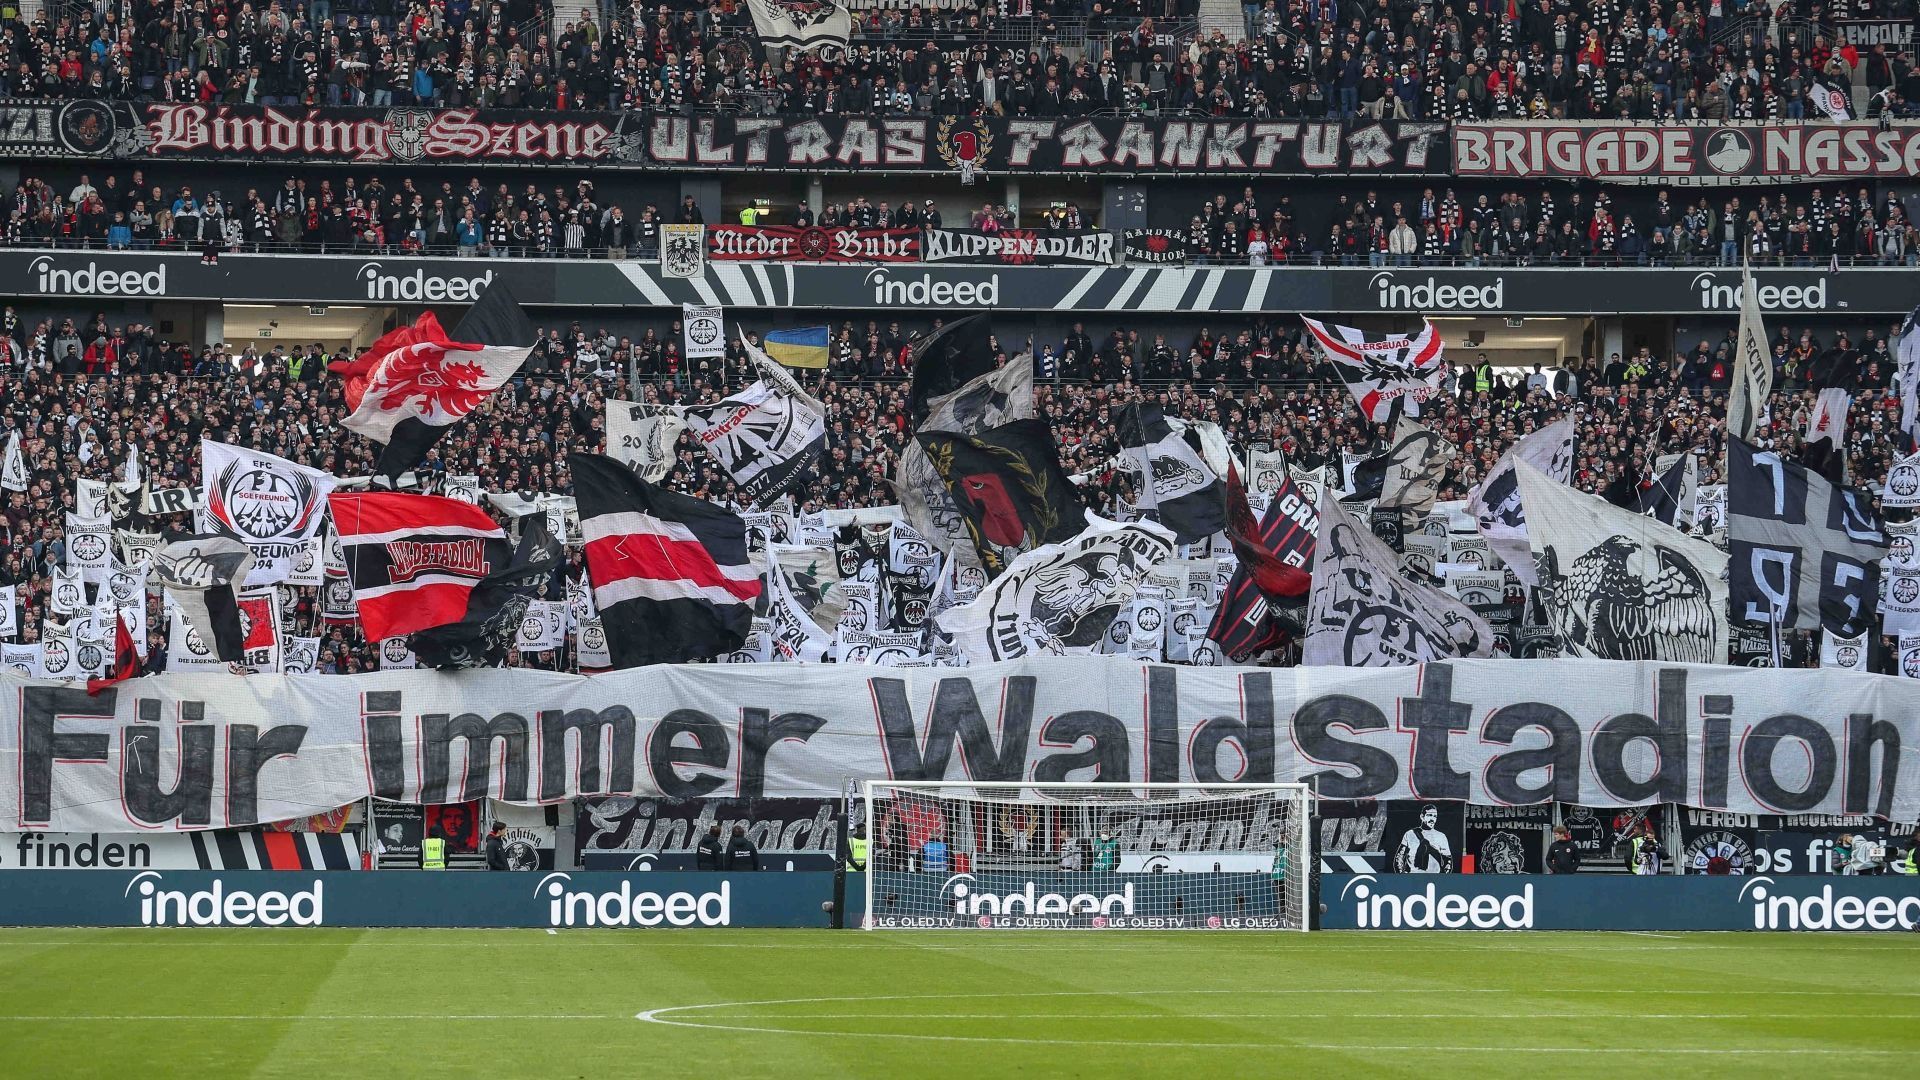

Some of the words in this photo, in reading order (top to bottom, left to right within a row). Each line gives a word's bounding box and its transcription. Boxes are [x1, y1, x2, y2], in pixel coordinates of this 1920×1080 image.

[147, 103, 392, 161] Binding
[426, 108, 613, 160] Szene
[650, 116, 926, 165] ULTRAS
[1008, 119, 1448, 170] FRANKFURT
[1454, 126, 1698, 178] BRIGADE
[1638, 175, 1803, 187] HOOLIGANS
[713, 229, 796, 257] Nieder
[834, 229, 913, 258] Bube
[925, 229, 1115, 264] KLIPPENADLER
[38, 262, 166, 297] indeed
[366, 267, 493, 301] indeed
[873, 273, 999, 306] indeed
[1378, 277, 1503, 310] indeed
[683, 309, 723, 320] WALDSTADION
[622, 434, 642, 450] 20
[252, 460, 273, 470] EFC
[1451, 540, 1489, 552] WALDSTADION
[333, 588, 350, 600] 25
[1451, 578, 1501, 592] WALDSTADION
[870, 635, 920, 651] WALDSTADION
[17, 686, 308, 829] Für
[359, 690, 828, 804] immer
[867, 663, 1902, 821] Waldstadion
[16, 832, 151, 867] finden
[501, 827, 543, 849] Fighting
[140, 879, 323, 926] indeed
[548, 879, 731, 926] indeed
[1355, 883, 1534, 928] indeed
[879, 918, 896, 927] LG
[901, 917, 935, 927] OLED
[935, 918, 955, 927] TV
[994, 918, 1011, 928] LG
[1016, 918, 1050, 928] OLED
[1050, 918, 1070, 928] TV
[1109, 918, 1126, 928] LG
[1131, 918, 1165, 928] OLED
[1167, 918, 1184, 928] TV
[1223, 918, 1240, 928] LG
[1245, 918, 1279, 928] OLED
